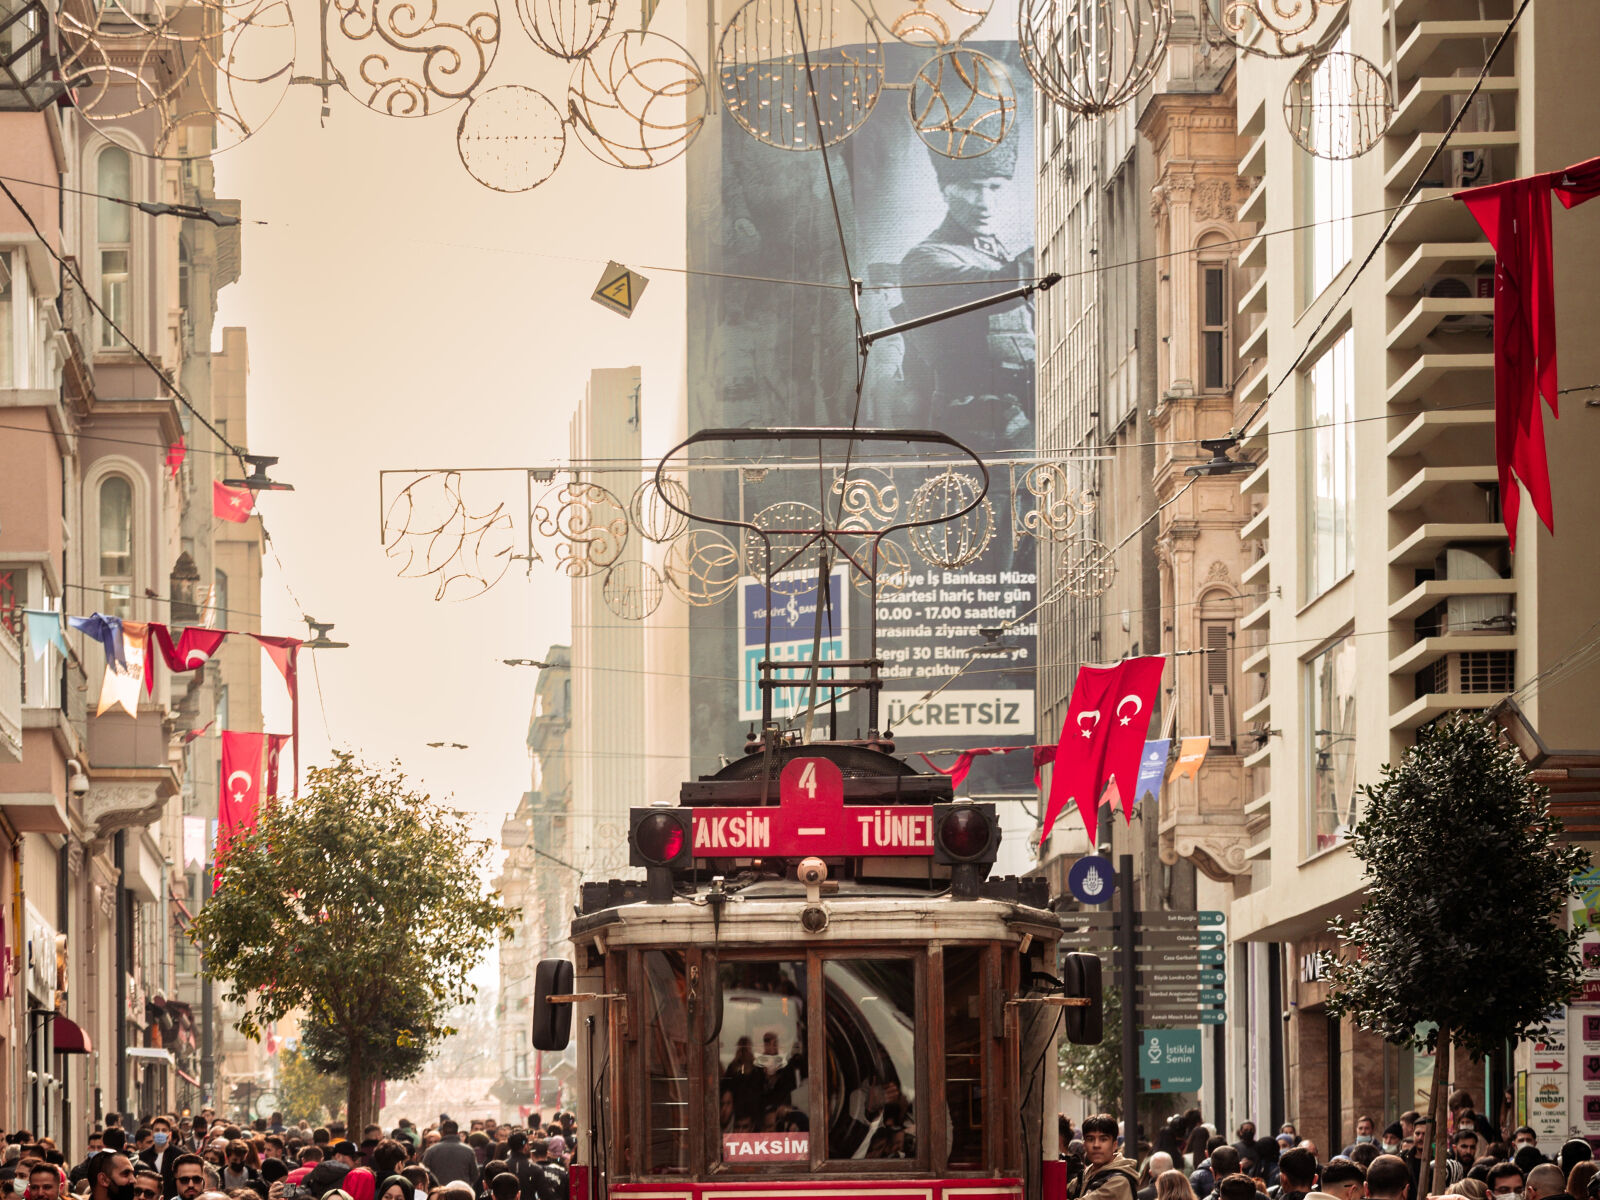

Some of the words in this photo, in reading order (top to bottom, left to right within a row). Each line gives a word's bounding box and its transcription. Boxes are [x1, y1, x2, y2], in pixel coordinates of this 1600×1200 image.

[927, 570, 939, 587] İş
[943, 572, 996, 585] Bankası
[1000, 571, 1037, 584] Müze
[939, 588, 974, 604] hariç
[976, 588, 1001, 602] her
[1004, 588, 1031, 604] gün
[753, 607, 787, 620] TÜRİYE
[798, 602, 833, 615] BANI
[924, 606, 961, 620] 17.00
[964, 605, 1016, 619] saatleri
[876, 624, 931, 637] arasında
[935, 623, 981, 639] ziyaret
[876, 647, 910, 662] Sergi
[912, 648, 931, 660] 30
[934, 646, 970, 659] Ekim
[887, 698, 1020, 726] ÜCRETSİZ
[798, 762, 817, 799] 4
[692, 810, 770, 848] AKSİM
[857, 810, 935, 847] TÜNEL
[1165, 1042, 1195, 1055] İstiklal
[1165, 1055, 1192, 1064] Senin
[725, 1136, 809, 1156] TAKSİM
